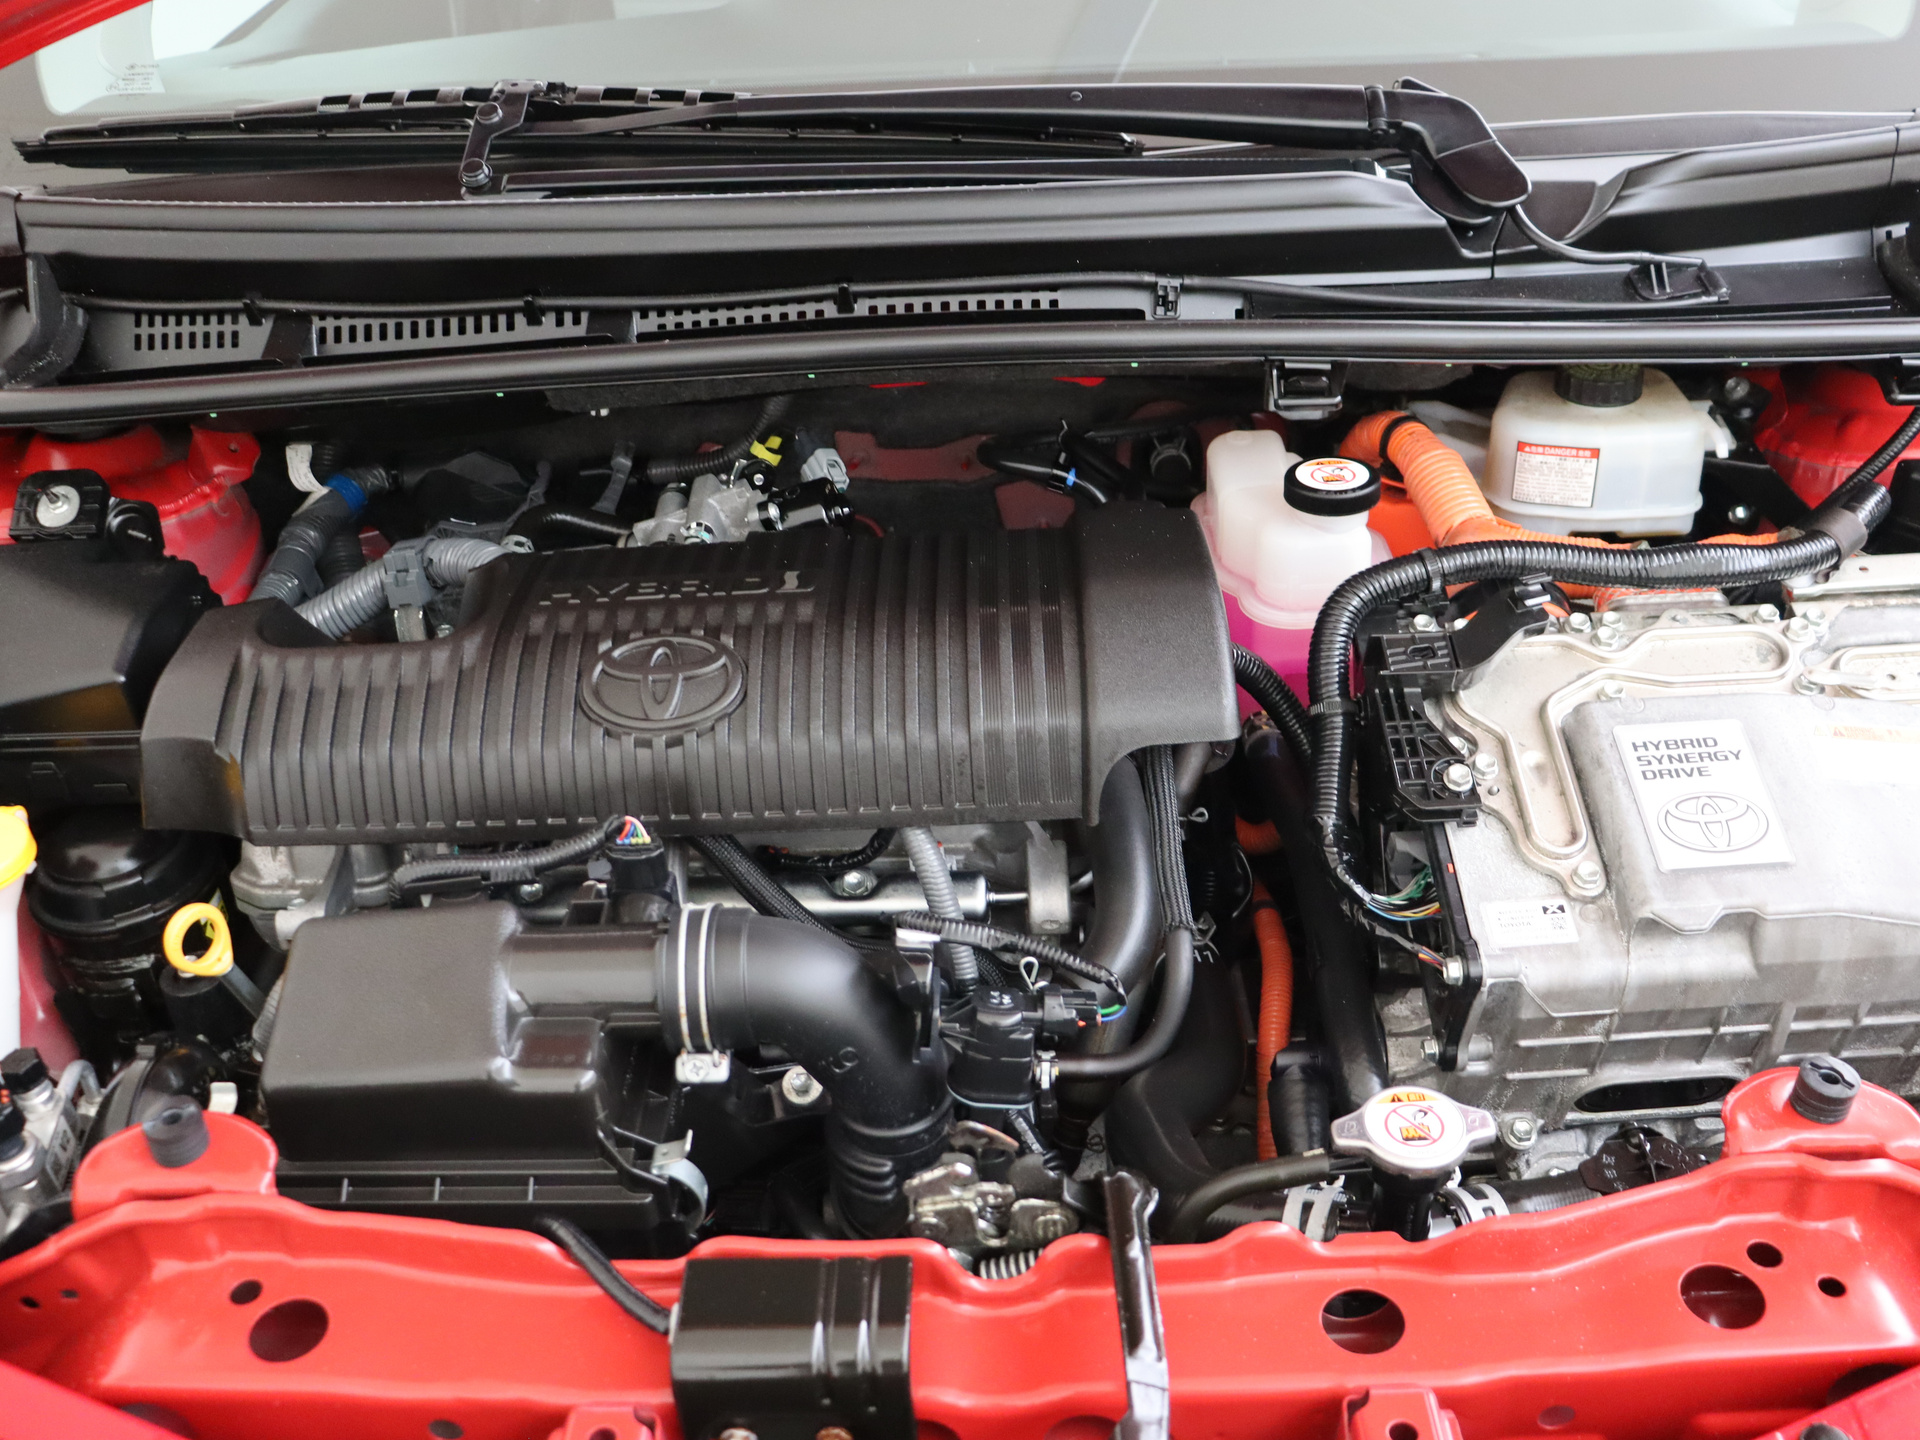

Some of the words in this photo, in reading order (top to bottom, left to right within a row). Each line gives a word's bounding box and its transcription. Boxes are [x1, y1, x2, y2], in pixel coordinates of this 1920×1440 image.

[1545, 447, 1577, 457] DANGER
[1631, 736, 1718, 752] HYBRID
[1636, 749, 1741, 767] SYNERGY
[1641, 765, 1712, 780] DRIVE
